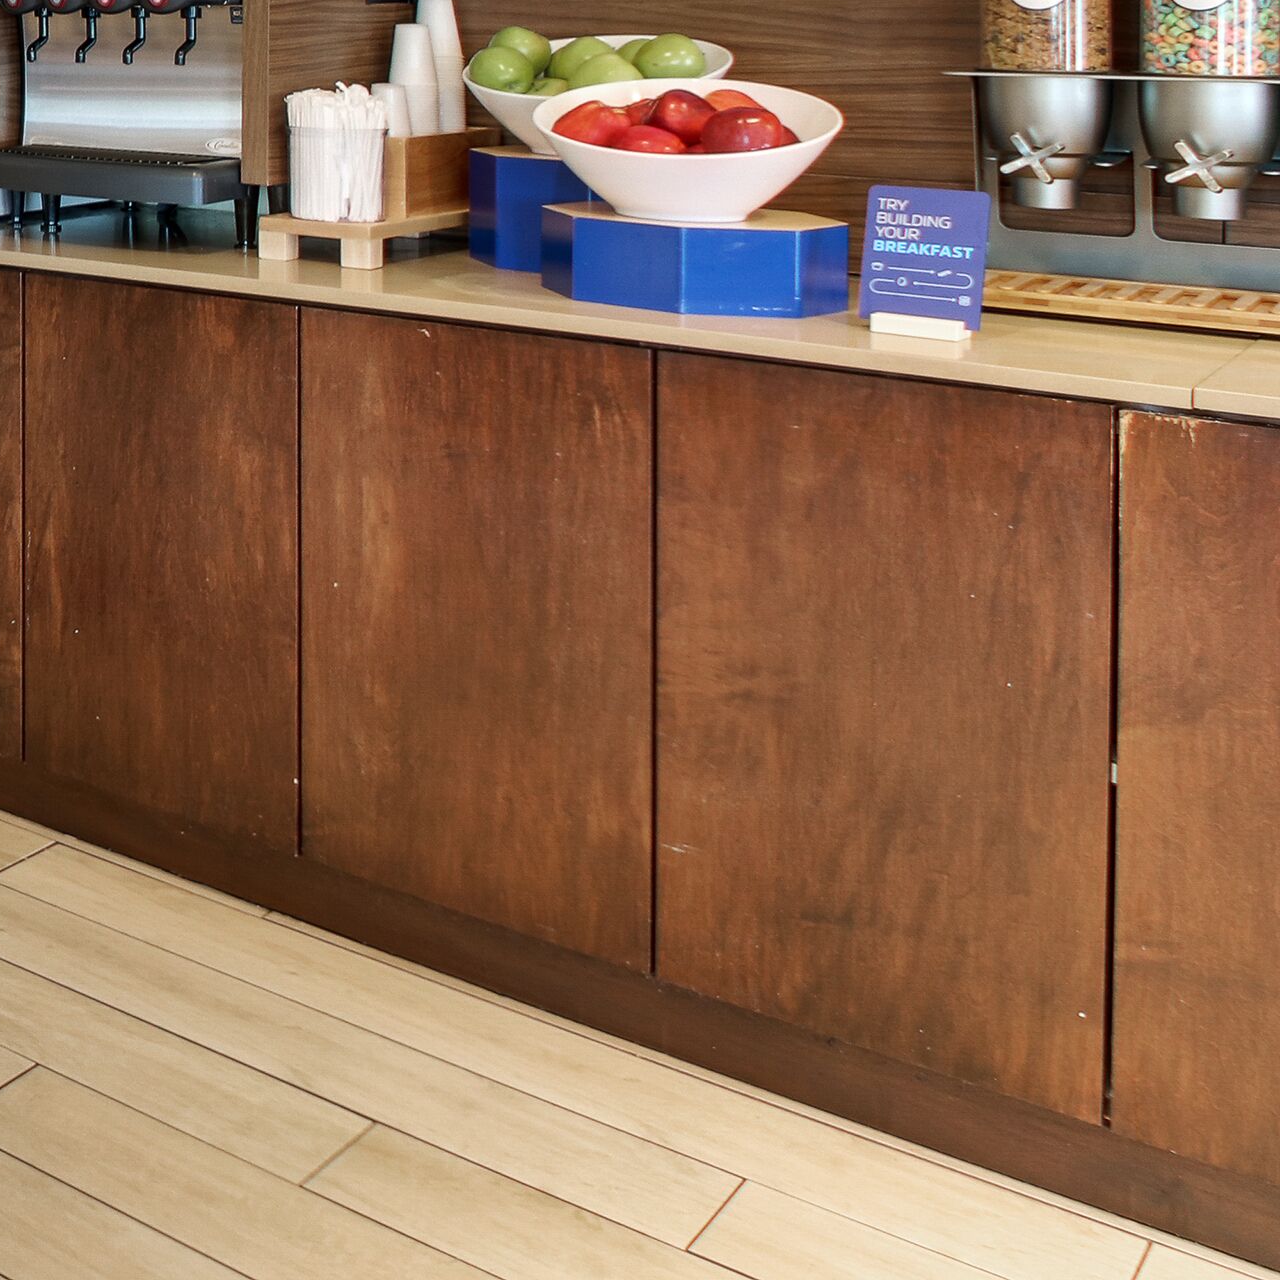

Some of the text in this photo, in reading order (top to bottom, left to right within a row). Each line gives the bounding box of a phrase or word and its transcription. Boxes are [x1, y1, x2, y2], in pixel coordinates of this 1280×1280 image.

[877, 197, 909, 211] TRY
[875, 211, 952, 229] BUILDING
[874, 226, 920, 240] YOUR
[873, 240, 974, 259] BREAKFAST
